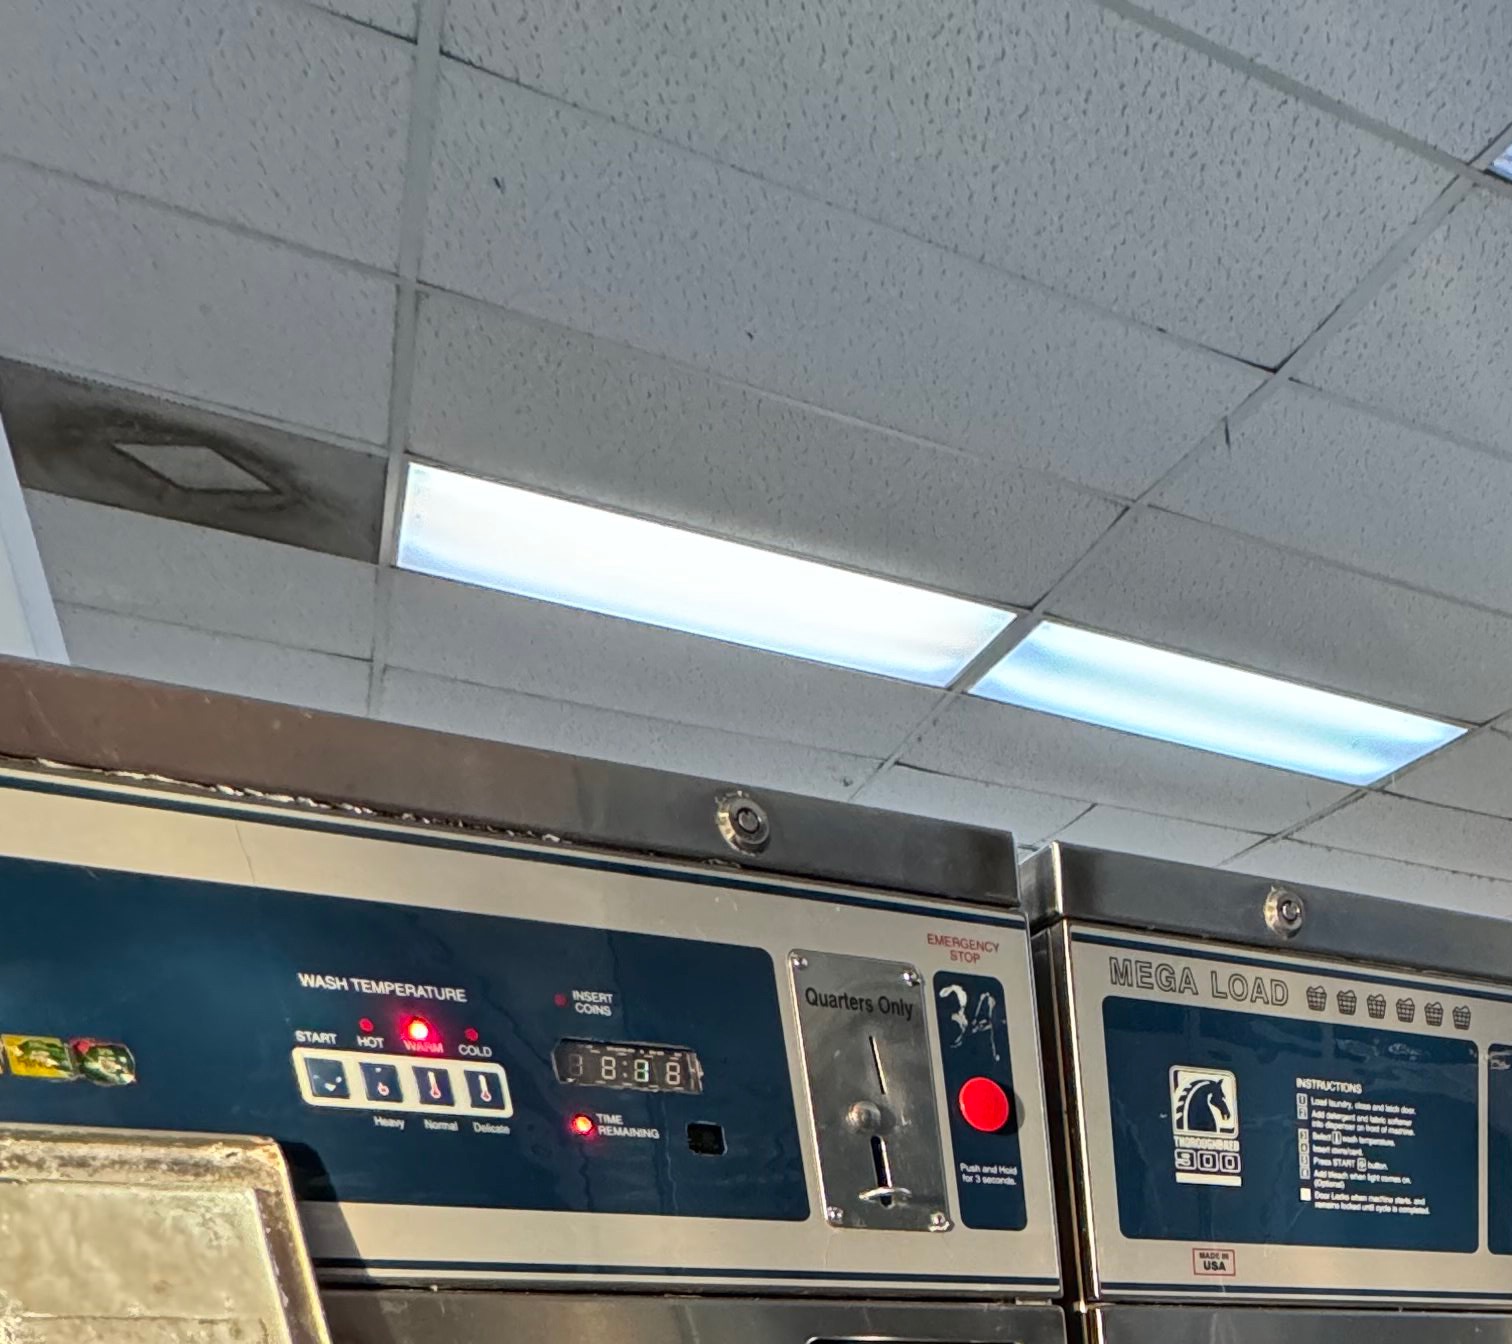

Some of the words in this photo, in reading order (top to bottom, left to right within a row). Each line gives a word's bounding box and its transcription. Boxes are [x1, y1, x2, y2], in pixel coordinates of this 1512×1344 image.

[927, 933, 1000, 953] EMERGENCY
[950, 950, 981, 964] STOP
[298, 973, 347, 991] WASH
[350, 978, 468, 1002] TEMPERATURE
[1109, 956, 1199, 996] MEGA
[1210, 970, 1289, 1006] LOAD
[572, 990, 613, 1004] INSERT
[575, 1002, 612, 1017] COINS
[805, 988, 874, 1014] Quarters
[878, 996, 914, 1021] Only
[295, 1030, 337, 1044] START
[357, 1035, 384, 1048] HOT
[403, 1040, 444, 1054] WARM
[458, 1044, 492, 1058] COLD
[1296, 1078, 1362, 1094] INSTRUCTIONS
[374, 1116, 405, 1130] Heavy
[424, 1119, 459, 1132] Normal
[472, 1122, 510, 1134] Delicate
[596, 1113, 624, 1125] TIME
[598, 1126, 660, 1140] REMAINING
[960, 1162, 981, 1172] Push
[982, 1165, 997, 1174] and
[999, 1166, 1018, 1176] Hold
[962, 1174, 973, 1182] for
[975, 1175, 980, 1183] 3
[1200, 1252, 1220, 1260] MADE
[1204, 1261, 1226, 1271] USA
